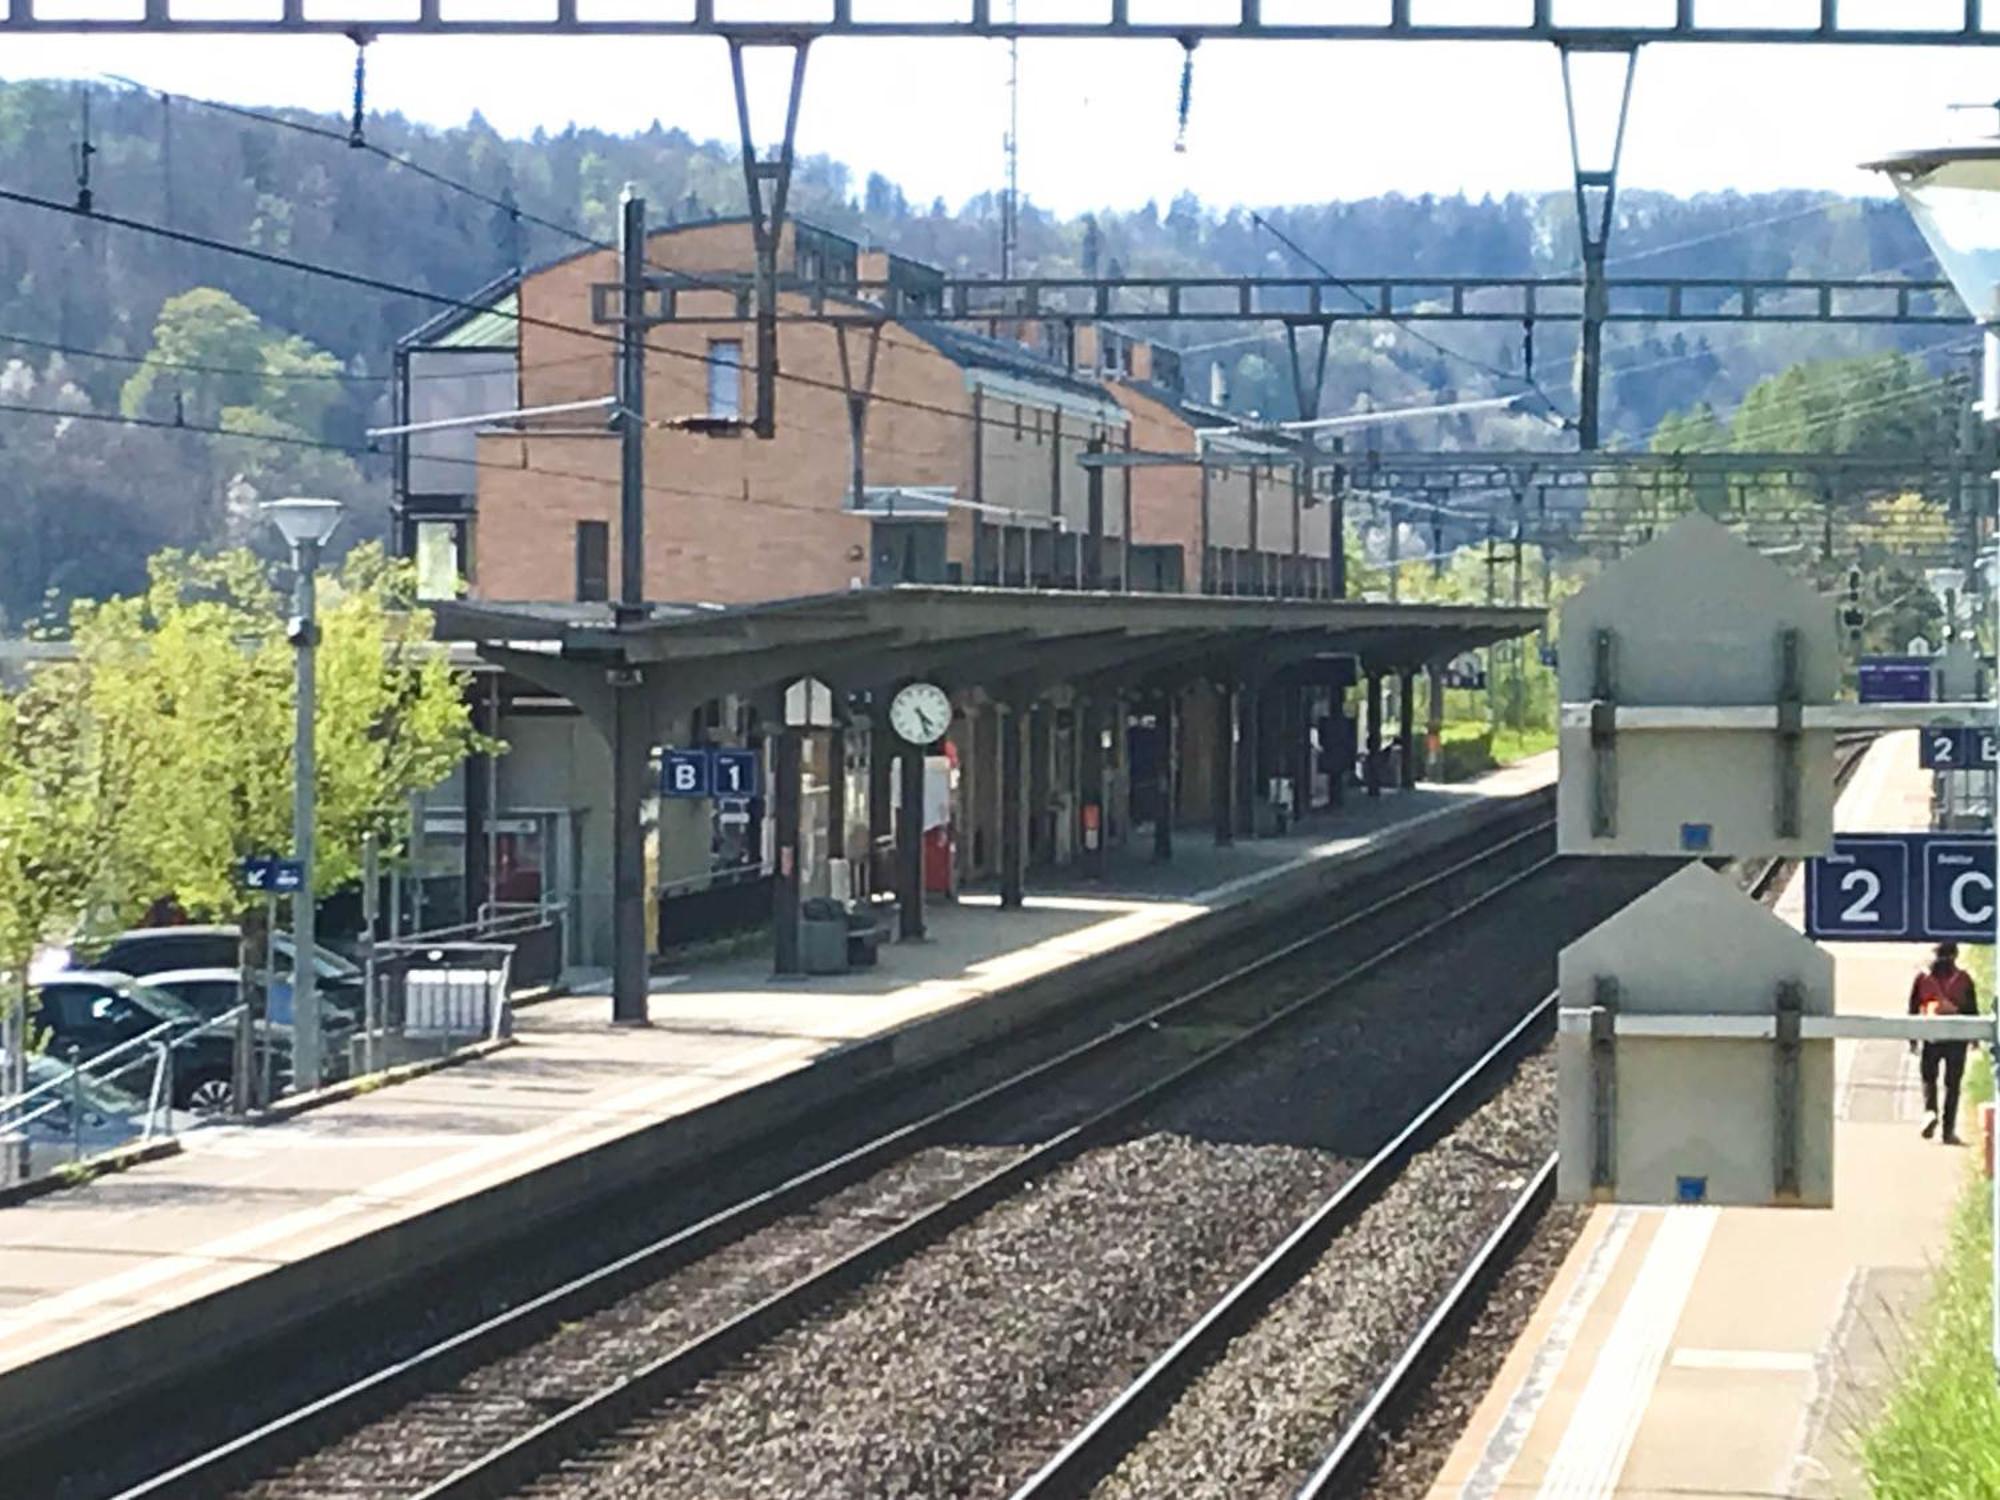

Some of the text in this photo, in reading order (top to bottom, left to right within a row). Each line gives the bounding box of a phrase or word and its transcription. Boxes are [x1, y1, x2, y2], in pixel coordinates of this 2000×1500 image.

[1933, 737, 1953, 762] 2
[675, 765, 740, 791] B 1
[1841, 869, 1994, 923] 2 C
